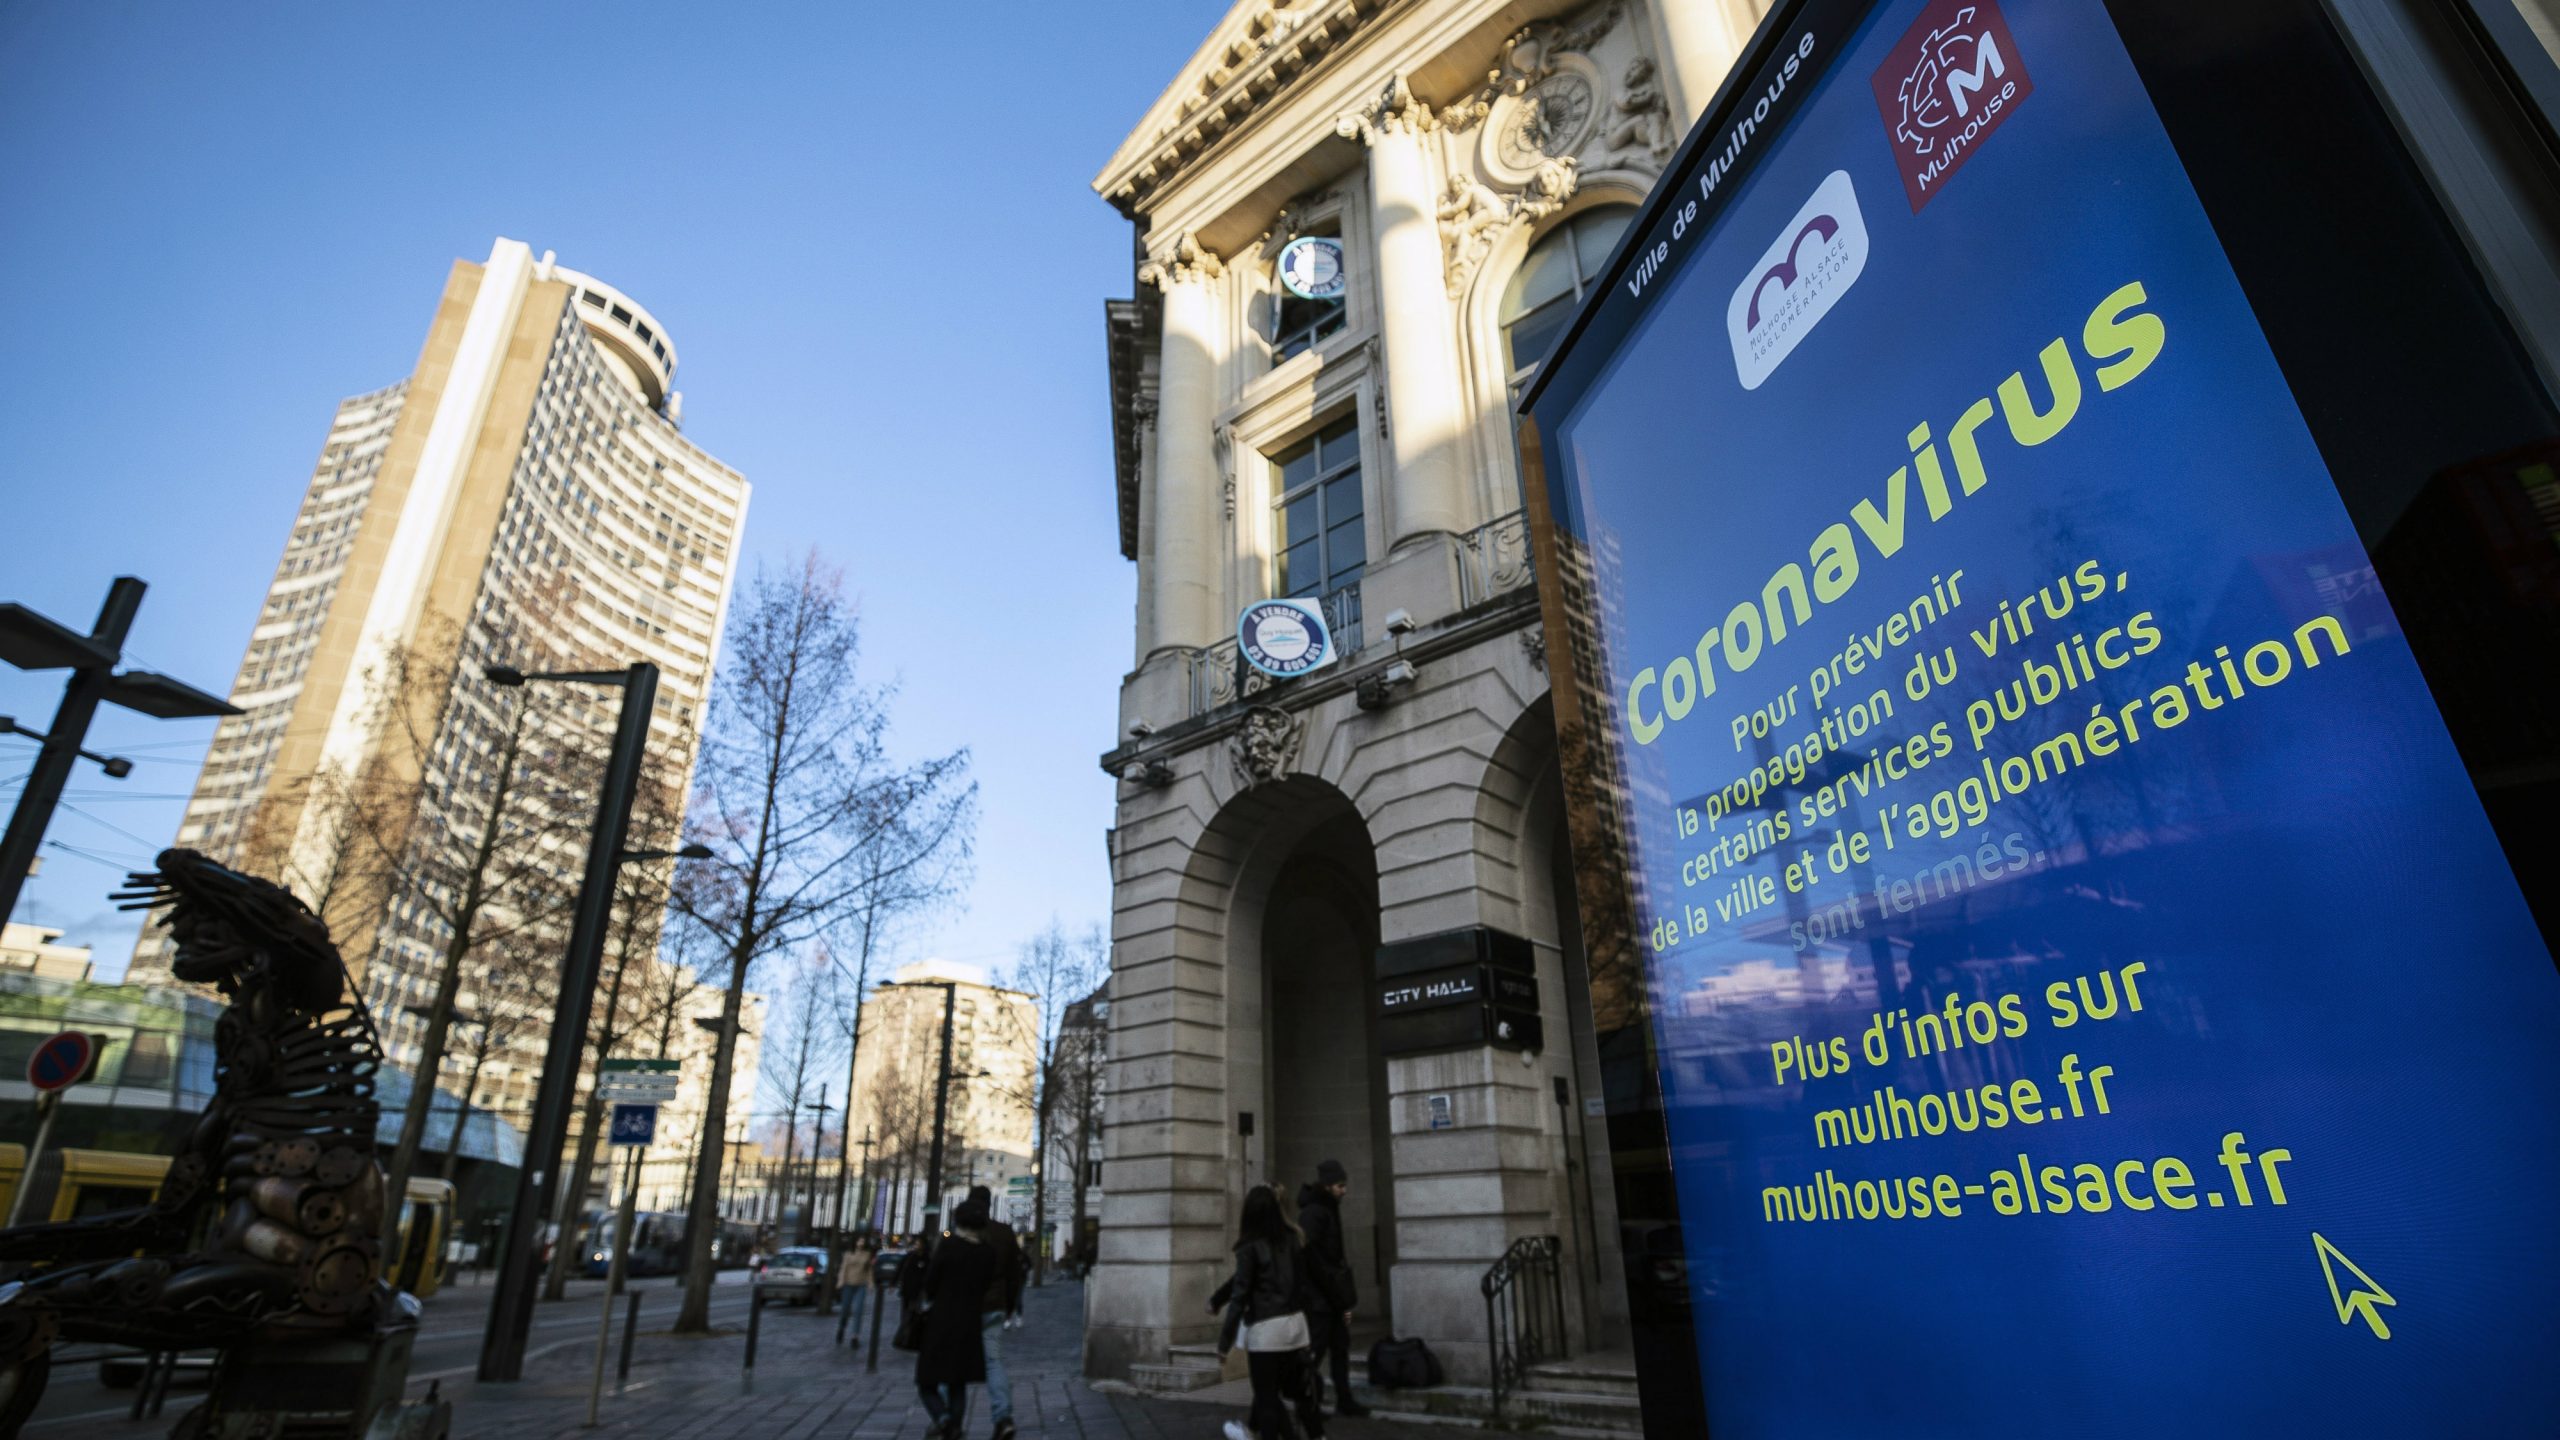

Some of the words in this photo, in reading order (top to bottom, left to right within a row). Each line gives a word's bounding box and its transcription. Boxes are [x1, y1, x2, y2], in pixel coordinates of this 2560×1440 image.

[1628, 240, 1669, 298] Ville
[1672, 200, 1698, 240] de
[1700, 32, 1816, 200] Mulhouse
[1918, 81, 2016, 191] Mulhouse
[1750, 291, 1799, 350] MULHOUSE
[1805, 238, 1845, 289] ALSACE
[1754, 252, 1849, 364] AGGLOMÉRATION
[1626, 280, 2166, 746] Coronavirus
[1259, 606, 1305, 622] VENDRE
[1731, 684, 1798, 753] Pour
[1809, 569, 1964, 711] prévenir
[1676, 807, 1699, 840] la
[1705, 689, 1894, 832] propagation
[1904, 646, 1958, 702] du
[1970, 559, 2127, 659] virus,
[1682, 809, 1792, 887] certains
[1799, 721, 1953, 828] services
[1965, 611, 2162, 752] publics
[1651, 916, 1680, 952] de
[1684, 904, 1709, 937] la
[1715, 874, 1776, 923] ville
[1784, 849, 1819, 894] et
[1826, 828, 1871, 875] de
[1878, 615, 2351, 850] l'agglomération
[1790, 892, 1865, 952] sont
[1873, 831, 2046, 920] fermés.
[1384, 987, 1420, 1006] CITY
[1426, 979, 1474, 998] HALL
[1770, 1035, 1851, 1086] Plus
[1862, 992, 2028, 1067] d'infos
[2045, 961, 2146, 1028] sur
[1814, 1053, 2114, 1149] mulhouse.fr
[1761, 1131, 2292, 1222] mulhouse-alsace.fr
